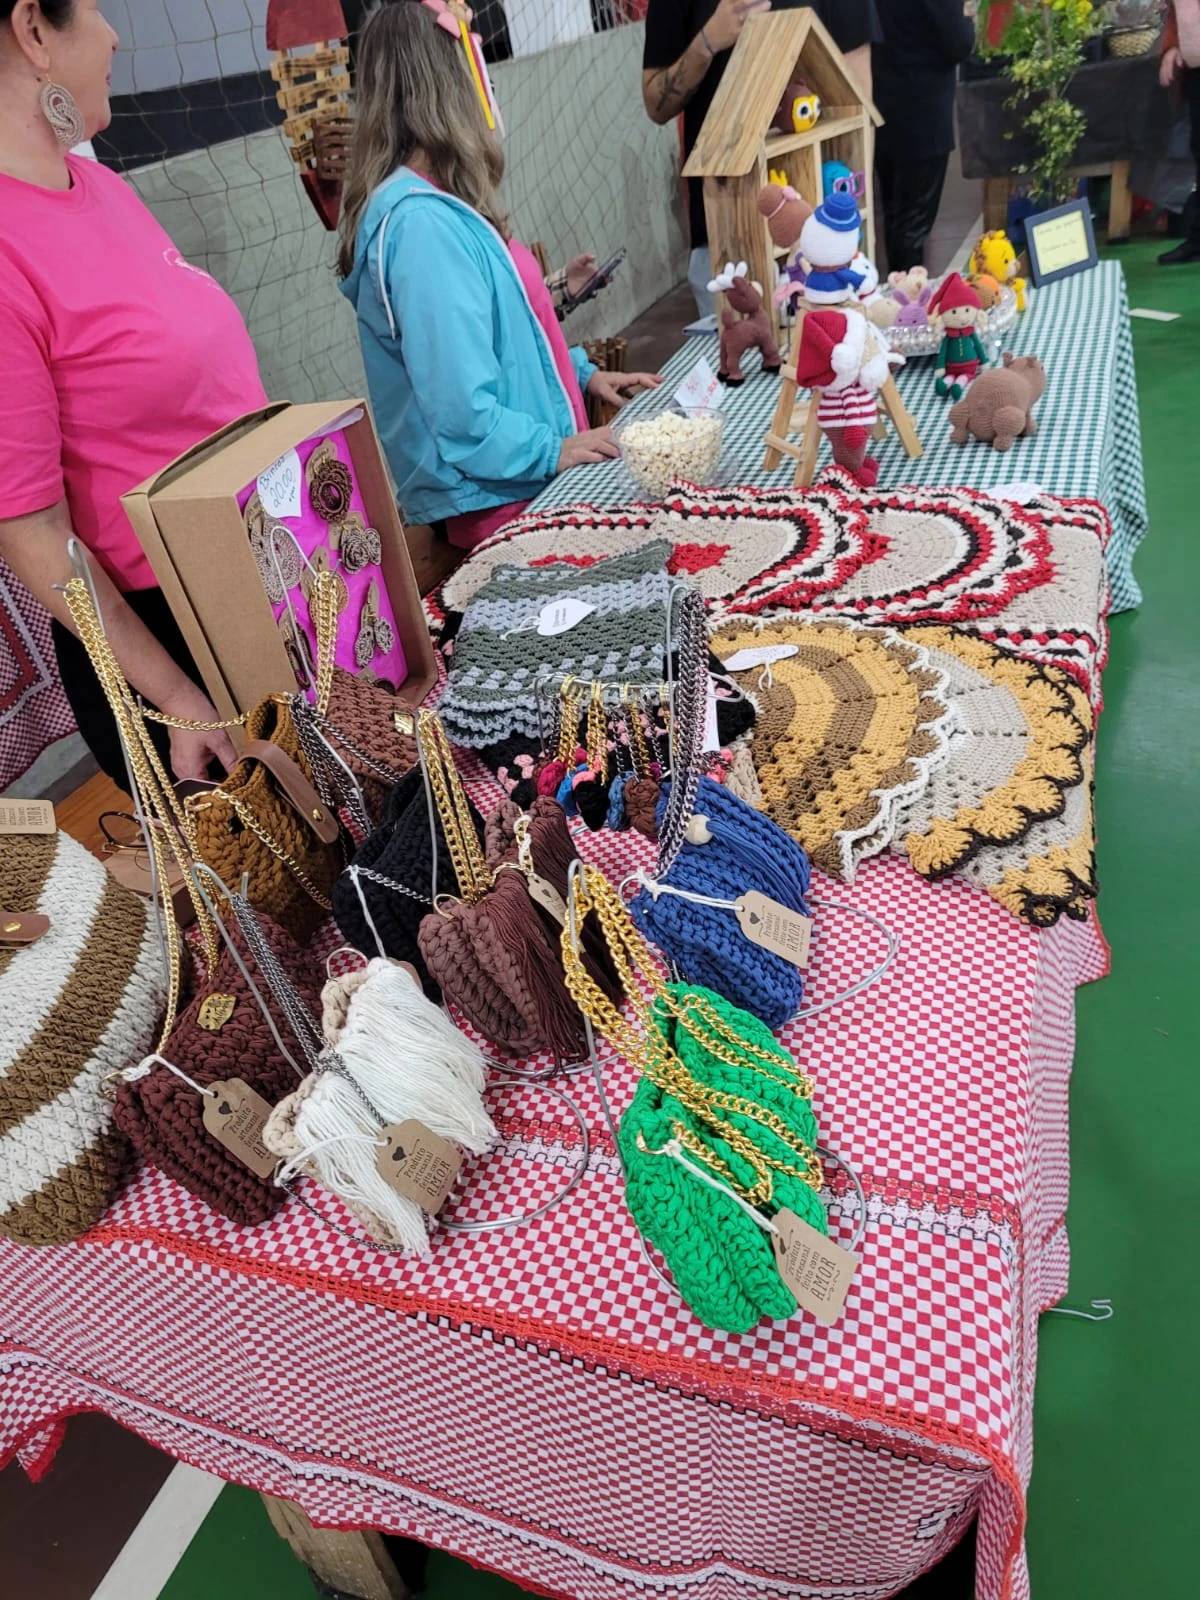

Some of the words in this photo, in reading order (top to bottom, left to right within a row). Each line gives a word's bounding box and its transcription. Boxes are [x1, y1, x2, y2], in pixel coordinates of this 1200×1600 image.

[786, 922, 800, 952] AMOR
[229, 1107, 252, 1133] Produto
[238, 1111, 260, 1141] artesanal
[403, 1148, 426, 1178] Produto
[413, 1151, 434, 1184] artesanal
[426, 1160, 451, 1197] AMOR
[430, 1156, 441, 1173] com
[788, 1239, 801, 1275] Produto
[795, 1244, 811, 1283] artesanal
[801, 1269, 814, 1290] feito
[809, 1250, 820, 1270] com
[810, 1257, 837, 1301] AMOR
